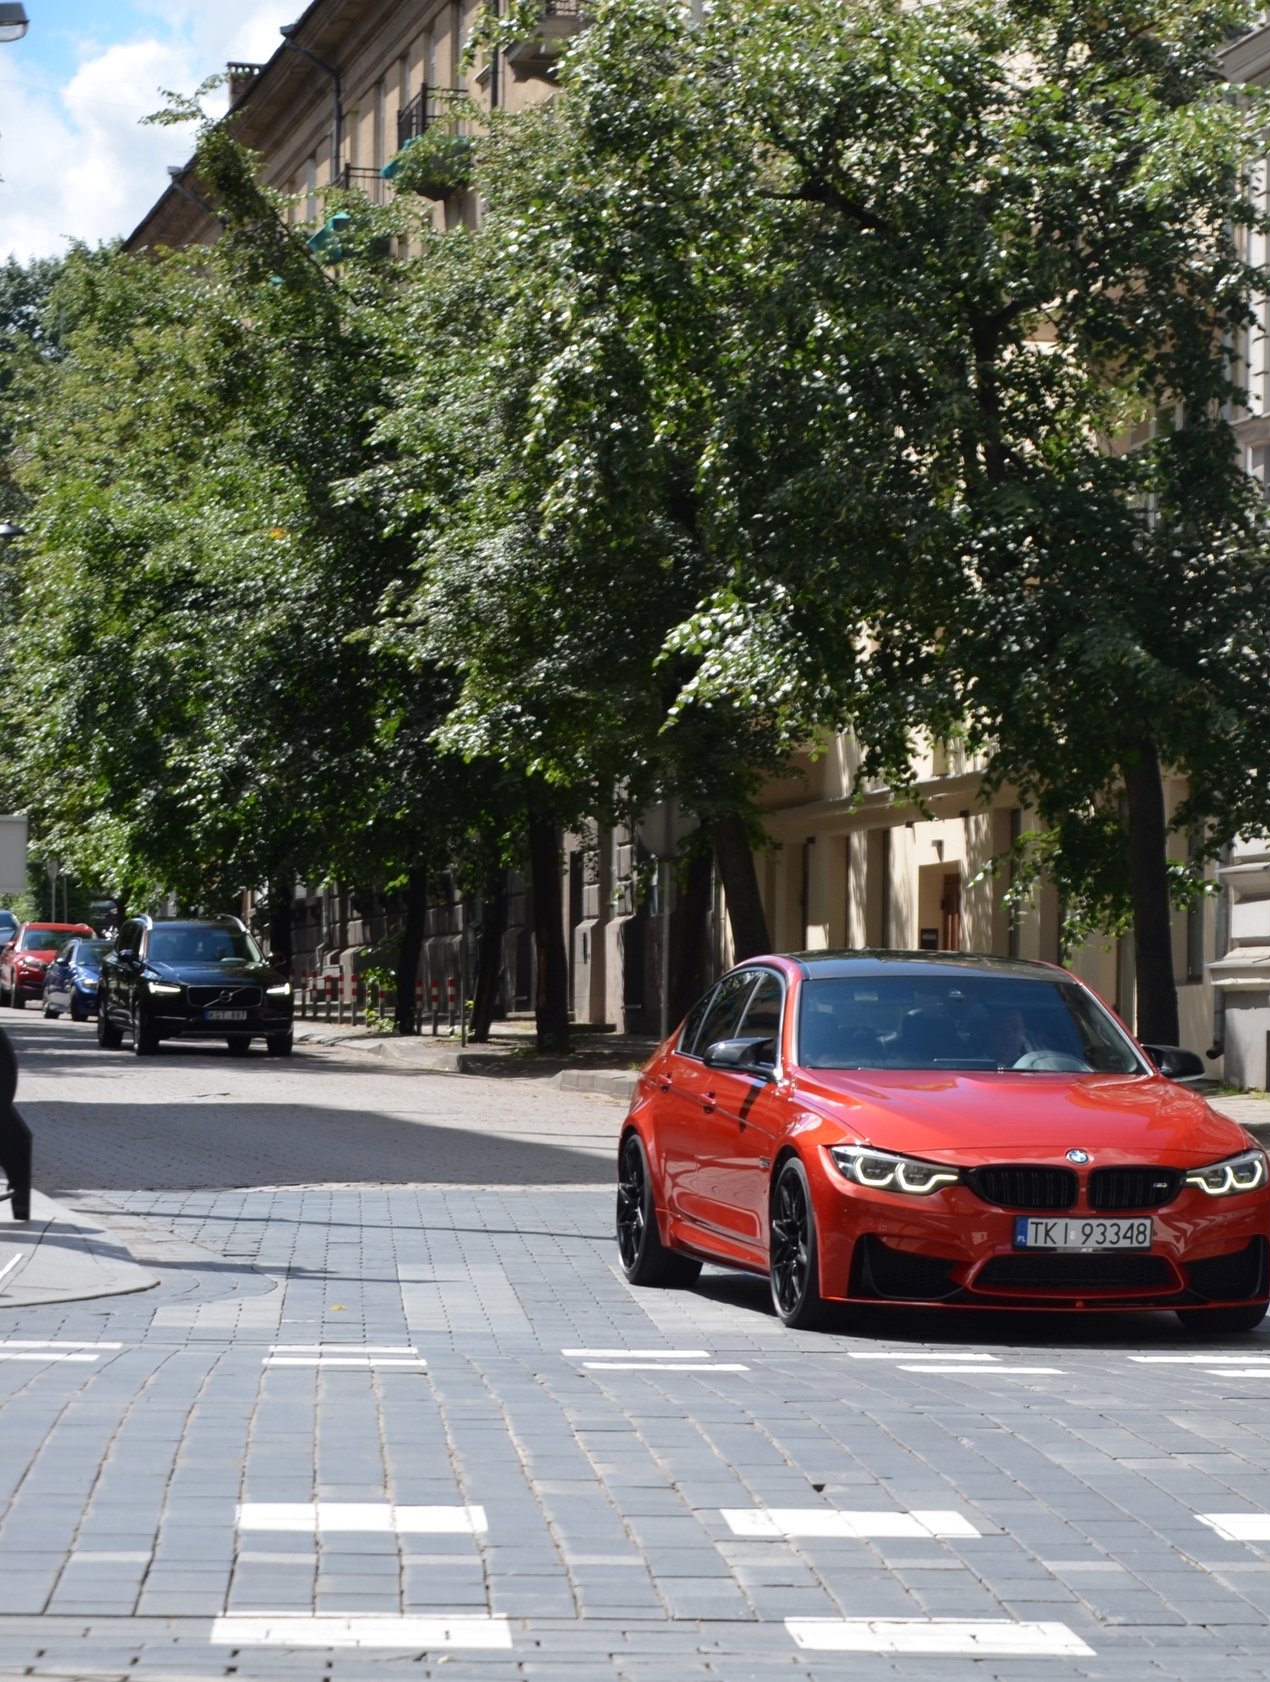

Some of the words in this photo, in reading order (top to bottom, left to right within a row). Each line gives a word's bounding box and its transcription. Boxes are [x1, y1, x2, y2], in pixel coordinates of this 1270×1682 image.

[209, 1011, 226, 1019] KGT
[1030, 1221, 1068, 1245] TKI
[1081, 1222, 1148, 1245] 93348
